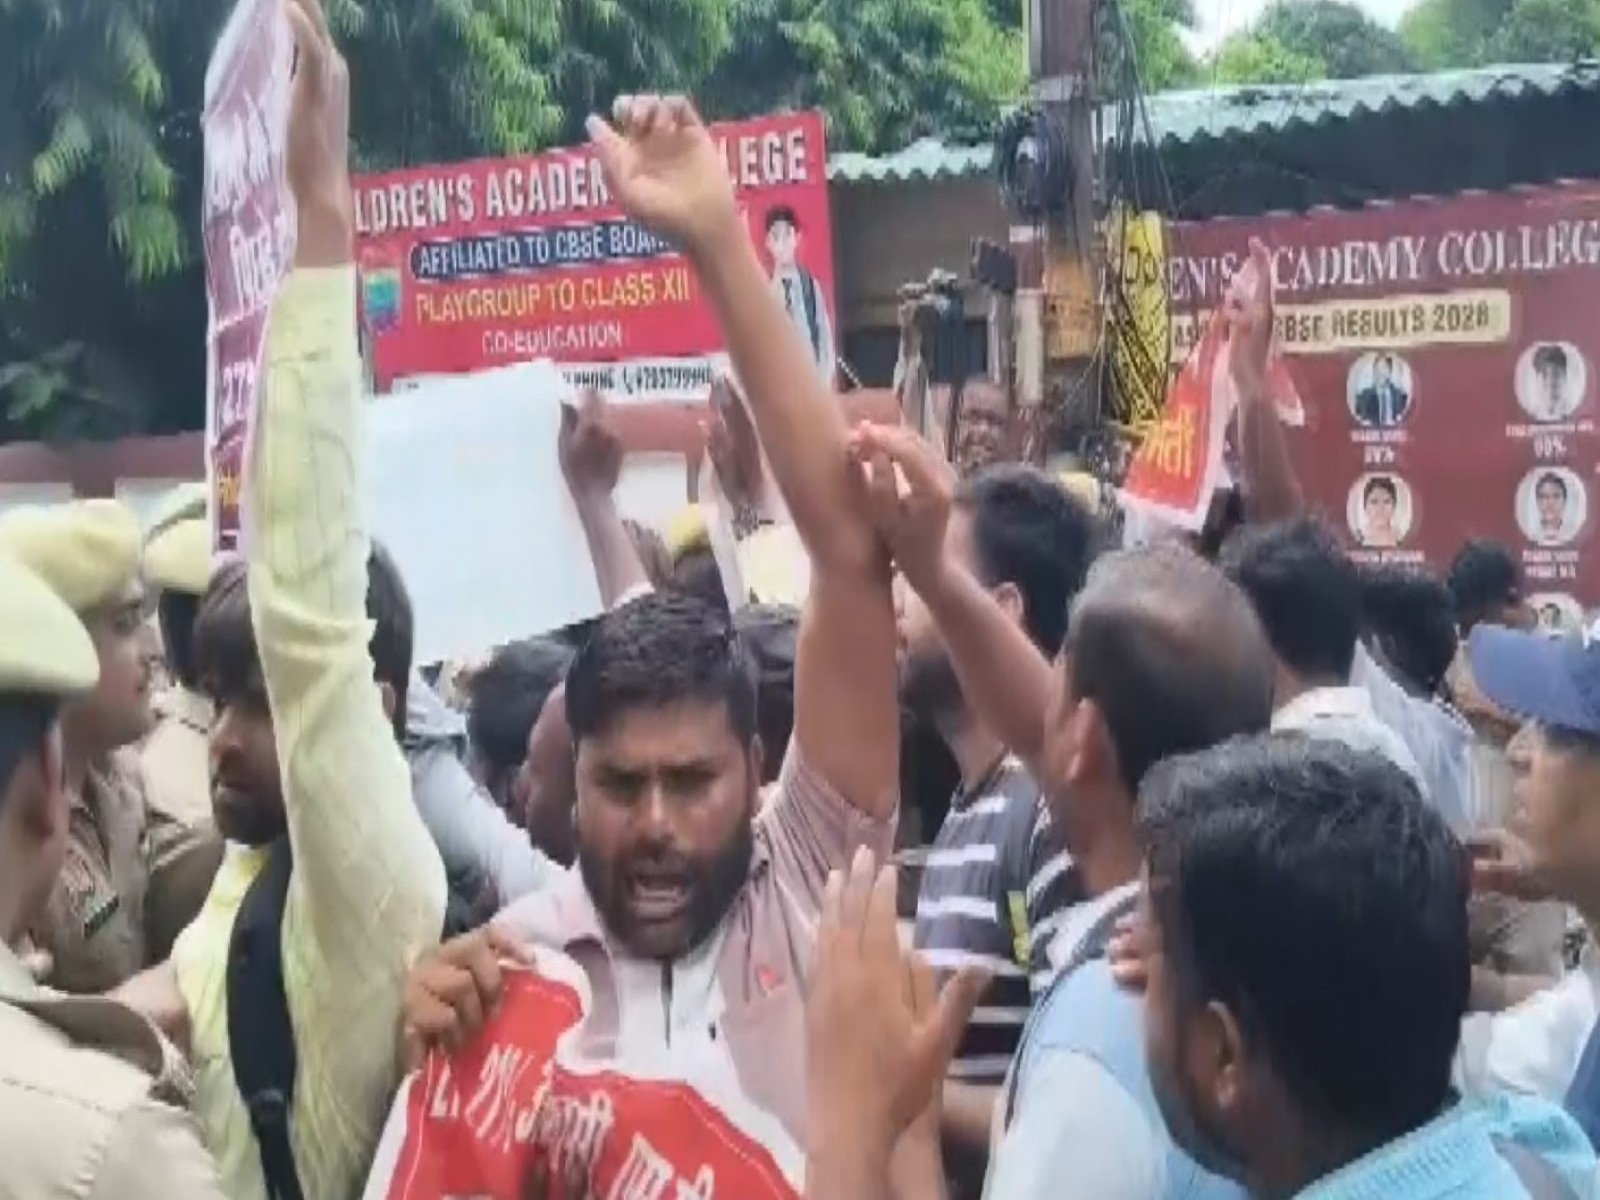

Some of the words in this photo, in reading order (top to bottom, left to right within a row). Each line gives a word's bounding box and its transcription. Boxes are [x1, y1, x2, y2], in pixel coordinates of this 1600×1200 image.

[353, 172, 476, 233] LDREN'S
[486, 156, 609, 217] ACADEM
[718, 127, 808, 186] LEGE
[419, 236, 521, 275] AFFILIATED
[523, 234, 550, 265] TO
[555, 227, 604, 260] CBSE
[609, 225, 656, 255] BOA
[1270, 236, 1426, 290] CADEMY
[1437, 219, 1600, 275] COLLEG
[415, 284, 541, 324] PLAYGROUP
[547, 278, 576, 311] TO
[581, 271, 656, 309] CLASS
[661, 267, 690, 301] XII
[1331, 303, 1425, 338] RESULTS
[481, 320, 623, 354] CO-EDUCATION
